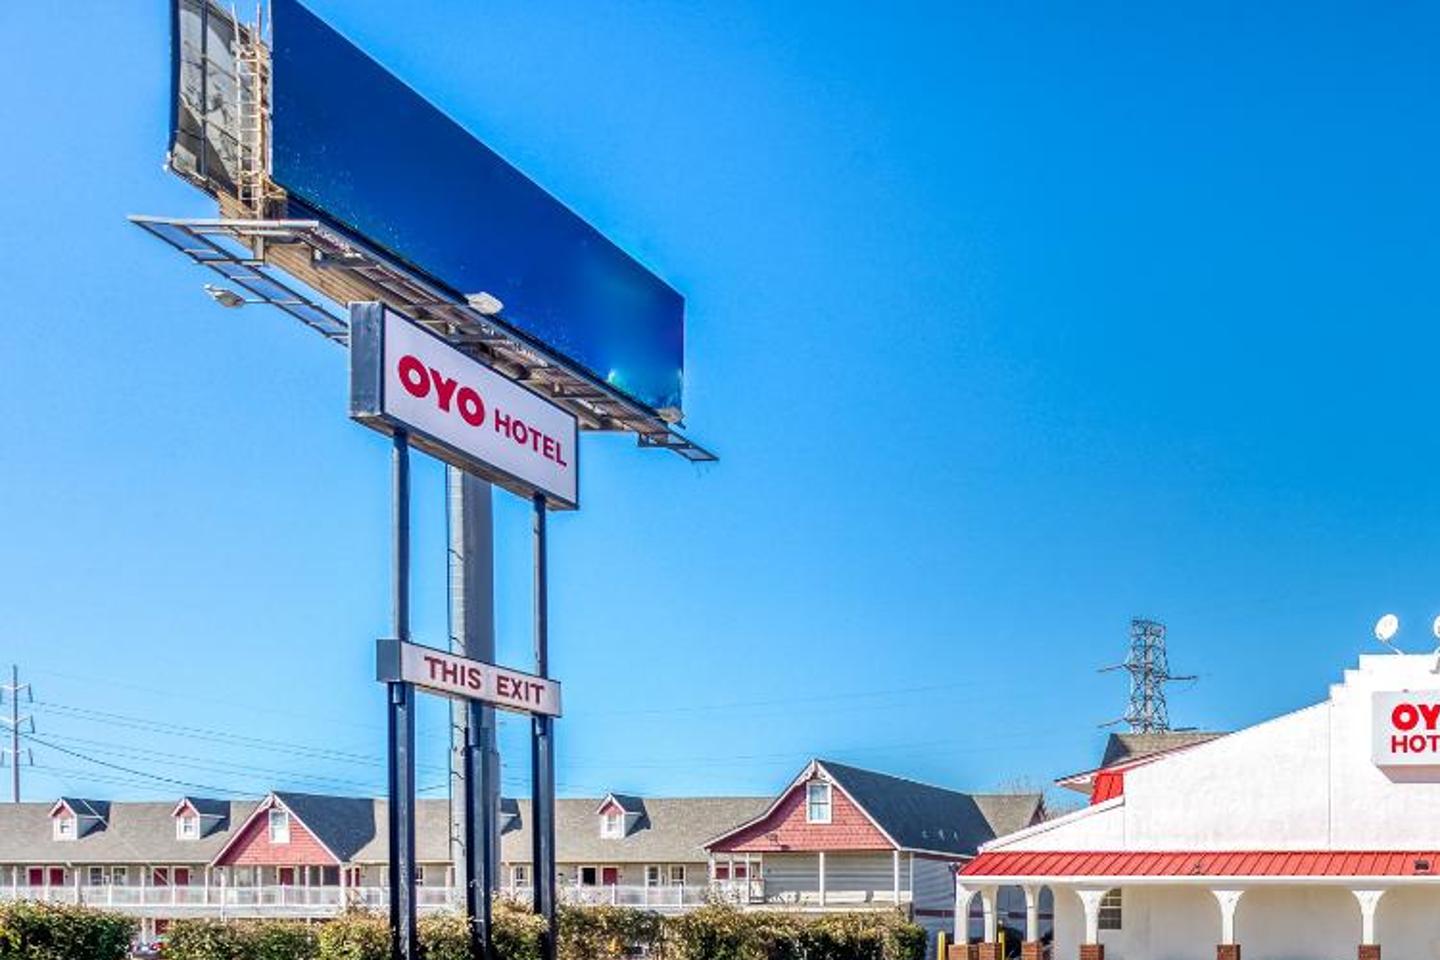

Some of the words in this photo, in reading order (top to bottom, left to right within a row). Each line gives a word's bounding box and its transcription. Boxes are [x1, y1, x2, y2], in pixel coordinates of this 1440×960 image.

[398, 355, 486, 427] OYO
[495, 408, 567, 467] HOTEL
[424, 656, 481, 690] THIS
[497, 676, 544, 704] EXIT
